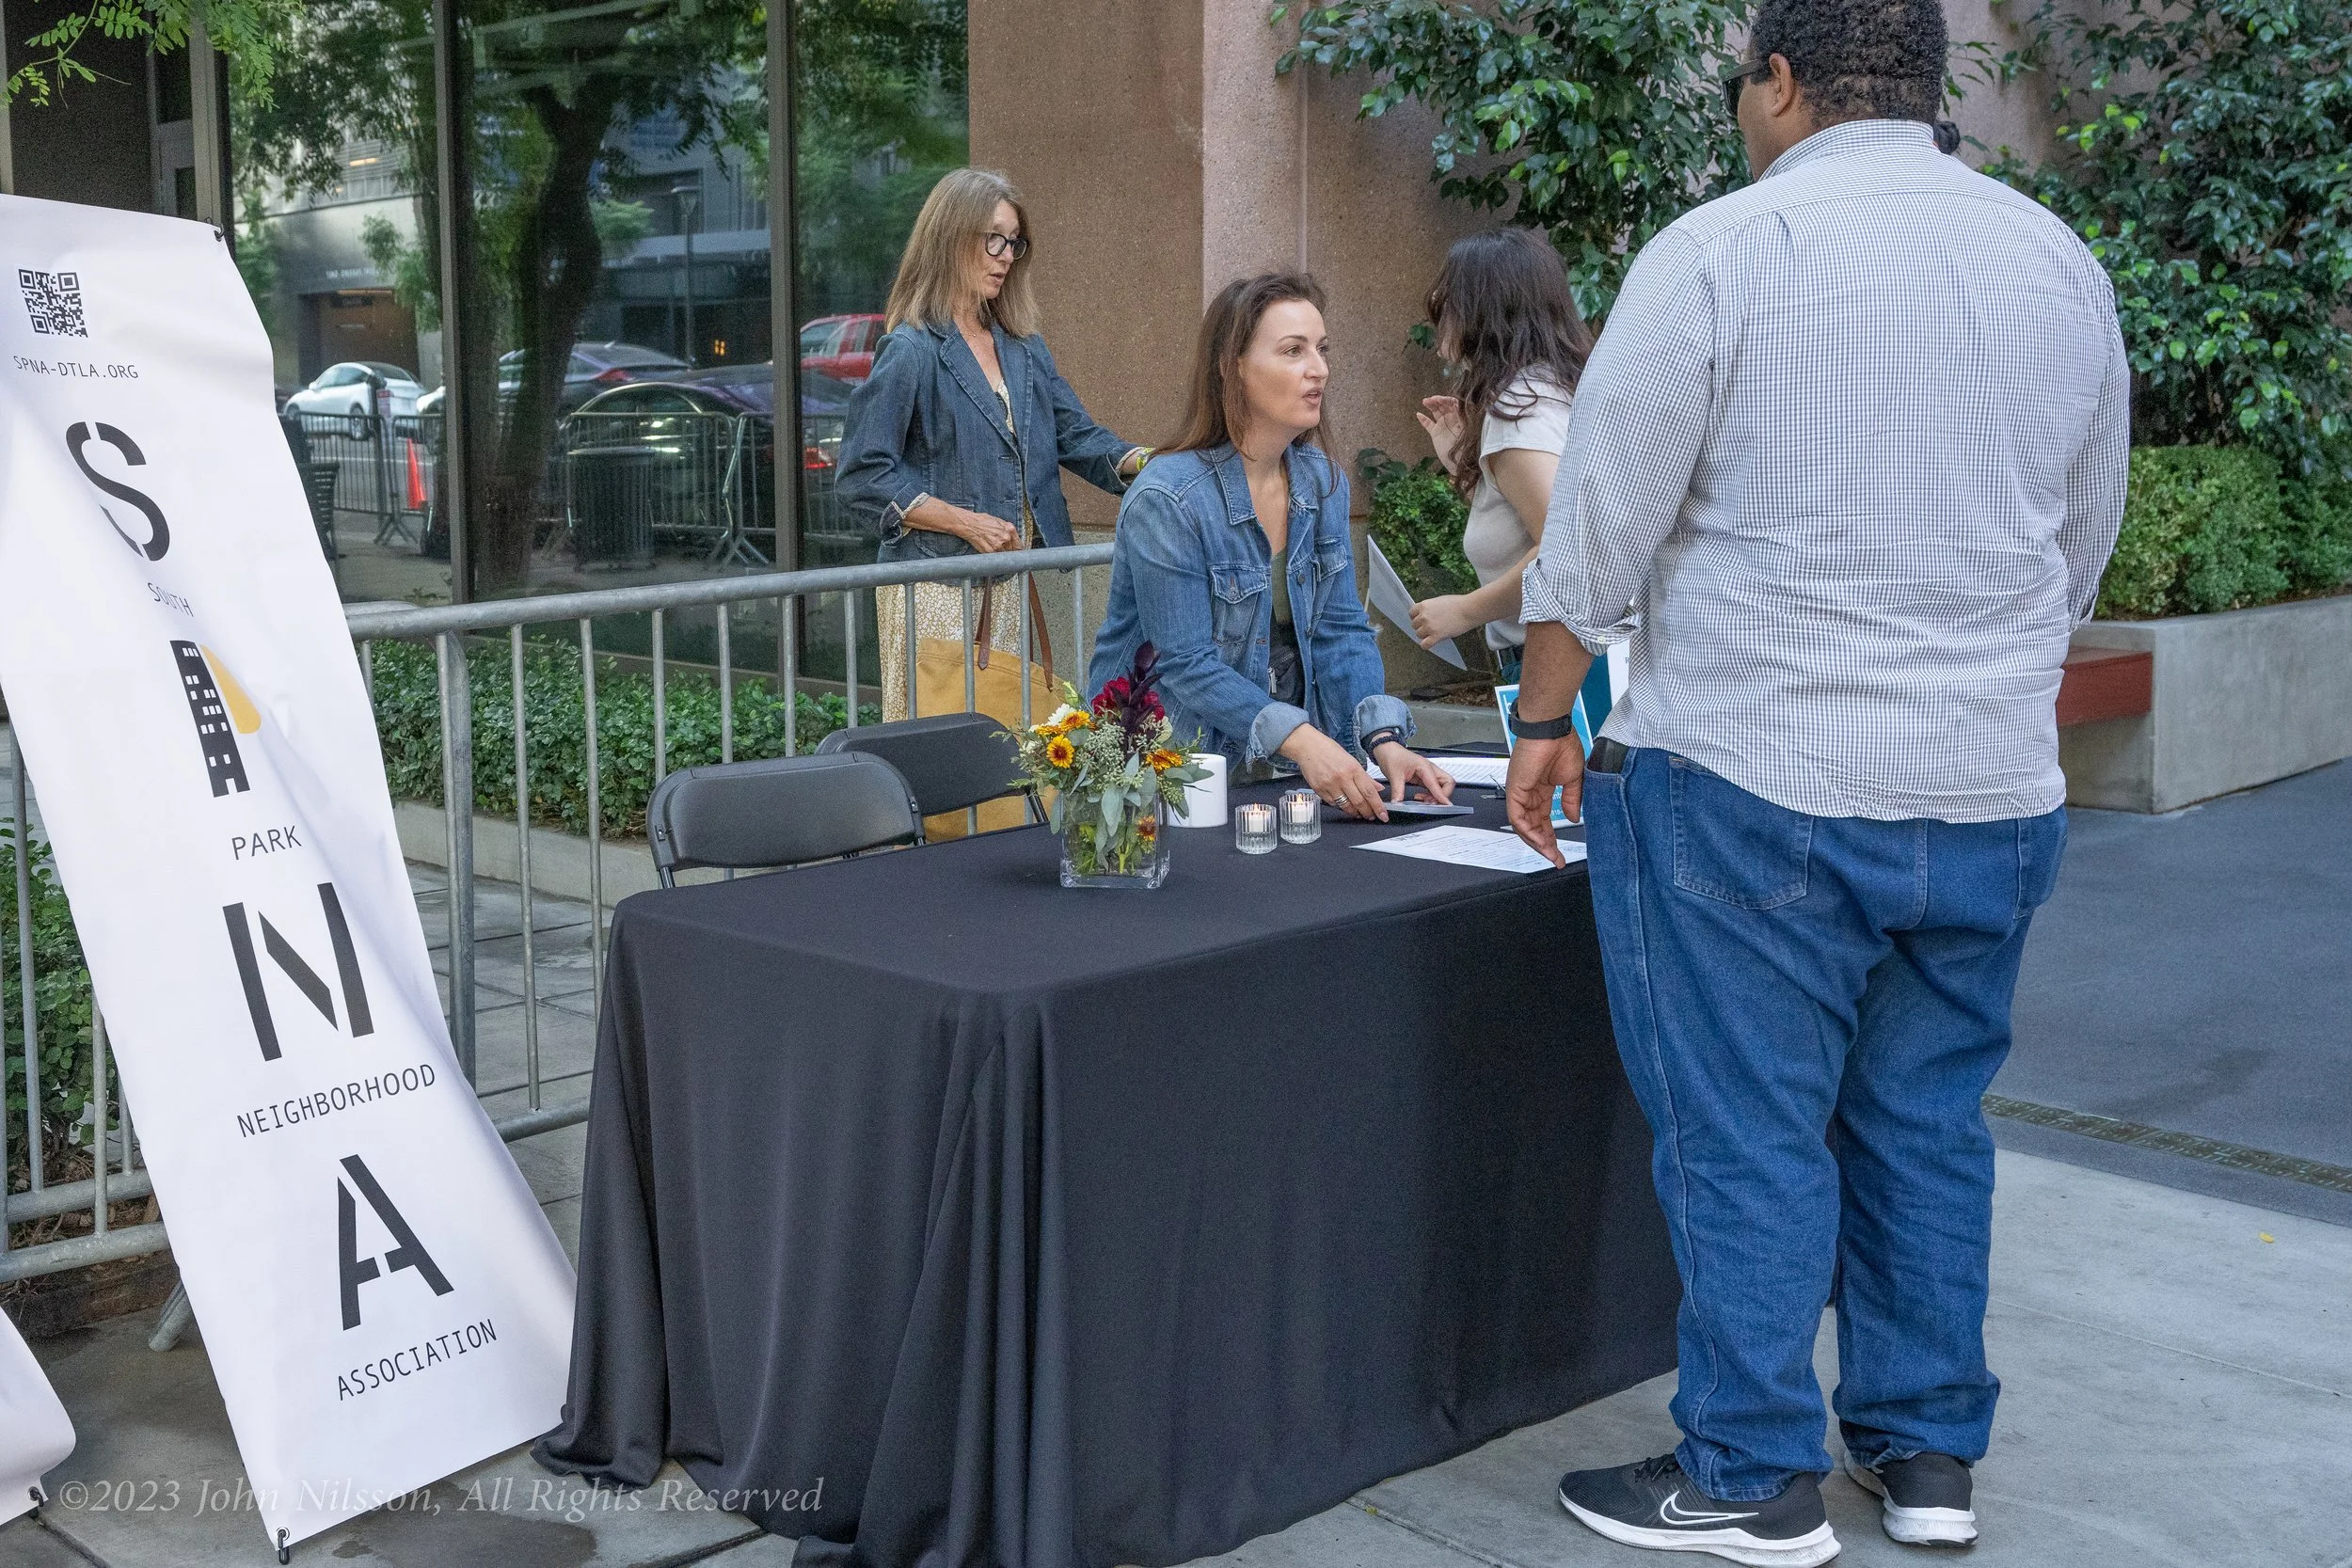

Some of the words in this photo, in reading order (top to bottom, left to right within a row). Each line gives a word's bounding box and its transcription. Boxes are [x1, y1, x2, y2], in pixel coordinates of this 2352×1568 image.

[13, 355, 139, 379] SPNA-DTLA.ORG
[66, 421, 170, 562] S
[147, 582, 195, 617] SOUTH
[231, 826, 302, 861] PARK
[222, 881, 374, 1062] N
[237, 1064, 436, 1138] NEIGHBORHOOD
[337, 1153, 455, 1332] A
[338, 1318, 498, 1402] ASSOCIATION
